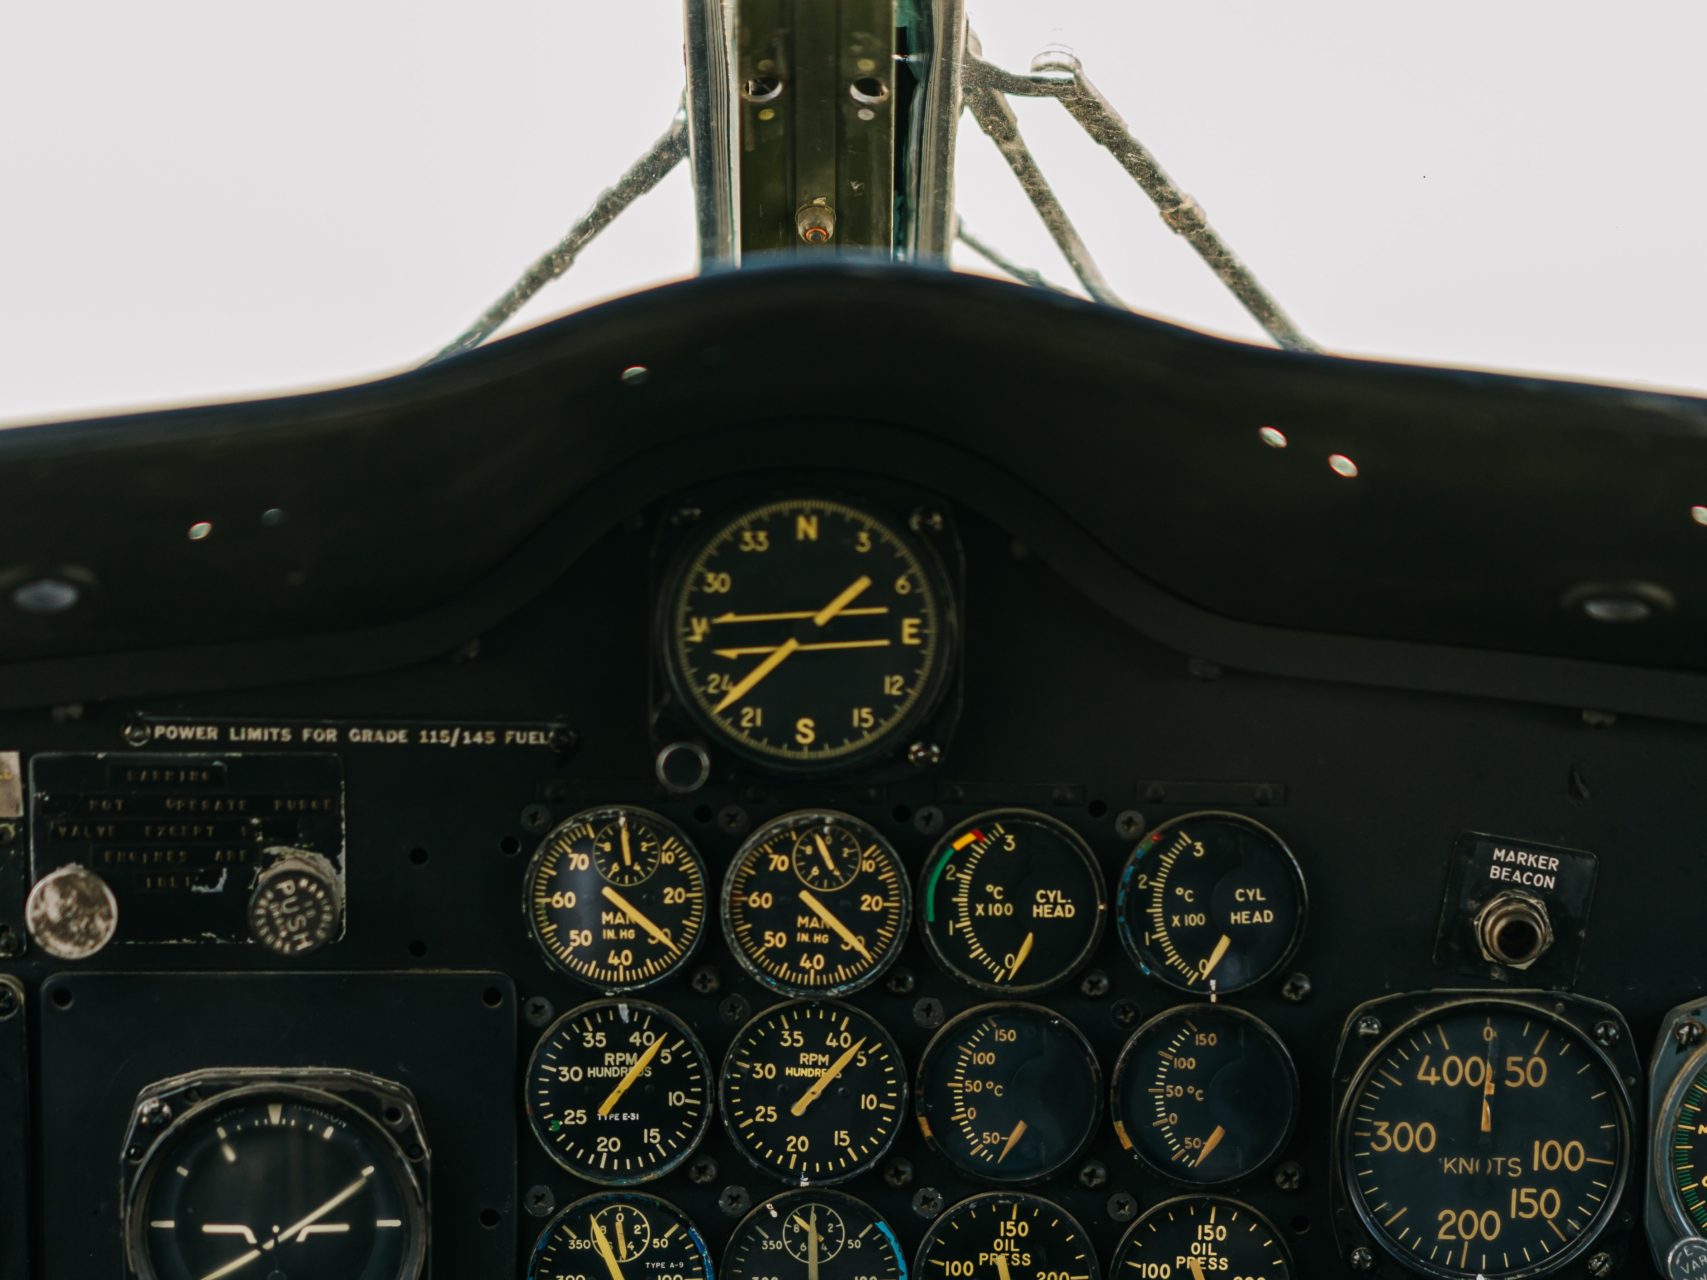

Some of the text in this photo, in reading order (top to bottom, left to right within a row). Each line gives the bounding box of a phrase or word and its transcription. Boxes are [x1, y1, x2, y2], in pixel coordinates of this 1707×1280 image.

[796, 516, 817, 540] N
[740, 531, 769, 552] 33
[856, 532, 871, 552] 3
[703, 573, 731, 593] 30
[896, 577, 910, 594] 6
[902, 618, 921, 643] E
[707, 674, 733, 694] 24
[884, 675, 903, 695] 12
[740, 707, 762, 727] 21
[854, 708, 874, 727] 15
[154, 725, 218, 740] POWER
[229, 727, 292, 742] LIMITS
[302, 728, 338, 742] FOR
[348, 728, 409, 743] GRADE
[419, 728, 496, 747] 115/145
[796, 719, 815, 743] S
[769, 855, 789, 872] 70
[1493, 848, 1559, 872] MARKER
[946, 864, 956, 880] 2
[1489, 865, 1556, 890] BEACON
[663, 888, 686, 904] 20
[1036, 890, 1072, 903] CYL.
[1235, 888, 1266, 901] CYL
[860, 895, 883, 912] 20
[1032, 905, 1075, 918] HEAD
[276, 880, 314, 951] PUSH
[1230, 910, 1274, 924] HEAD
[620, 929, 635, 939] HG
[813, 934, 829, 943] HG
[583, 1032, 606, 1047] 35
[994, 1029, 1017, 1042] 150
[605, 1053, 638, 1065] RPM
[661, 1050, 672, 1064] 5
[800, 1053, 829, 1065] RPM
[752, 1063, 776, 1079] 30
[1417, 1056, 1486, 1086] 400
[1505, 1056, 1547, 1088] 50
[965, 1080, 982, 1092] 50
[1166, 1085, 1183, 1097] 50
[755, 1106, 778, 1122] 25
[643, 1129, 660, 1143] 15
[1370, 1122, 1436, 1152] 300
[1533, 1140, 1585, 1172] 100
[1510, 1188, 1560, 1219] 150
[1438, 1210, 1500, 1240] 200
[568, 1240, 591, 1249] 350
[994, 1239, 1019, 1251] OIL
[1191, 1242, 1217, 1256] OIL
[1176, 1256, 1228, 1270] PRESS
[1142, 1264, 1170, 1279] 100
